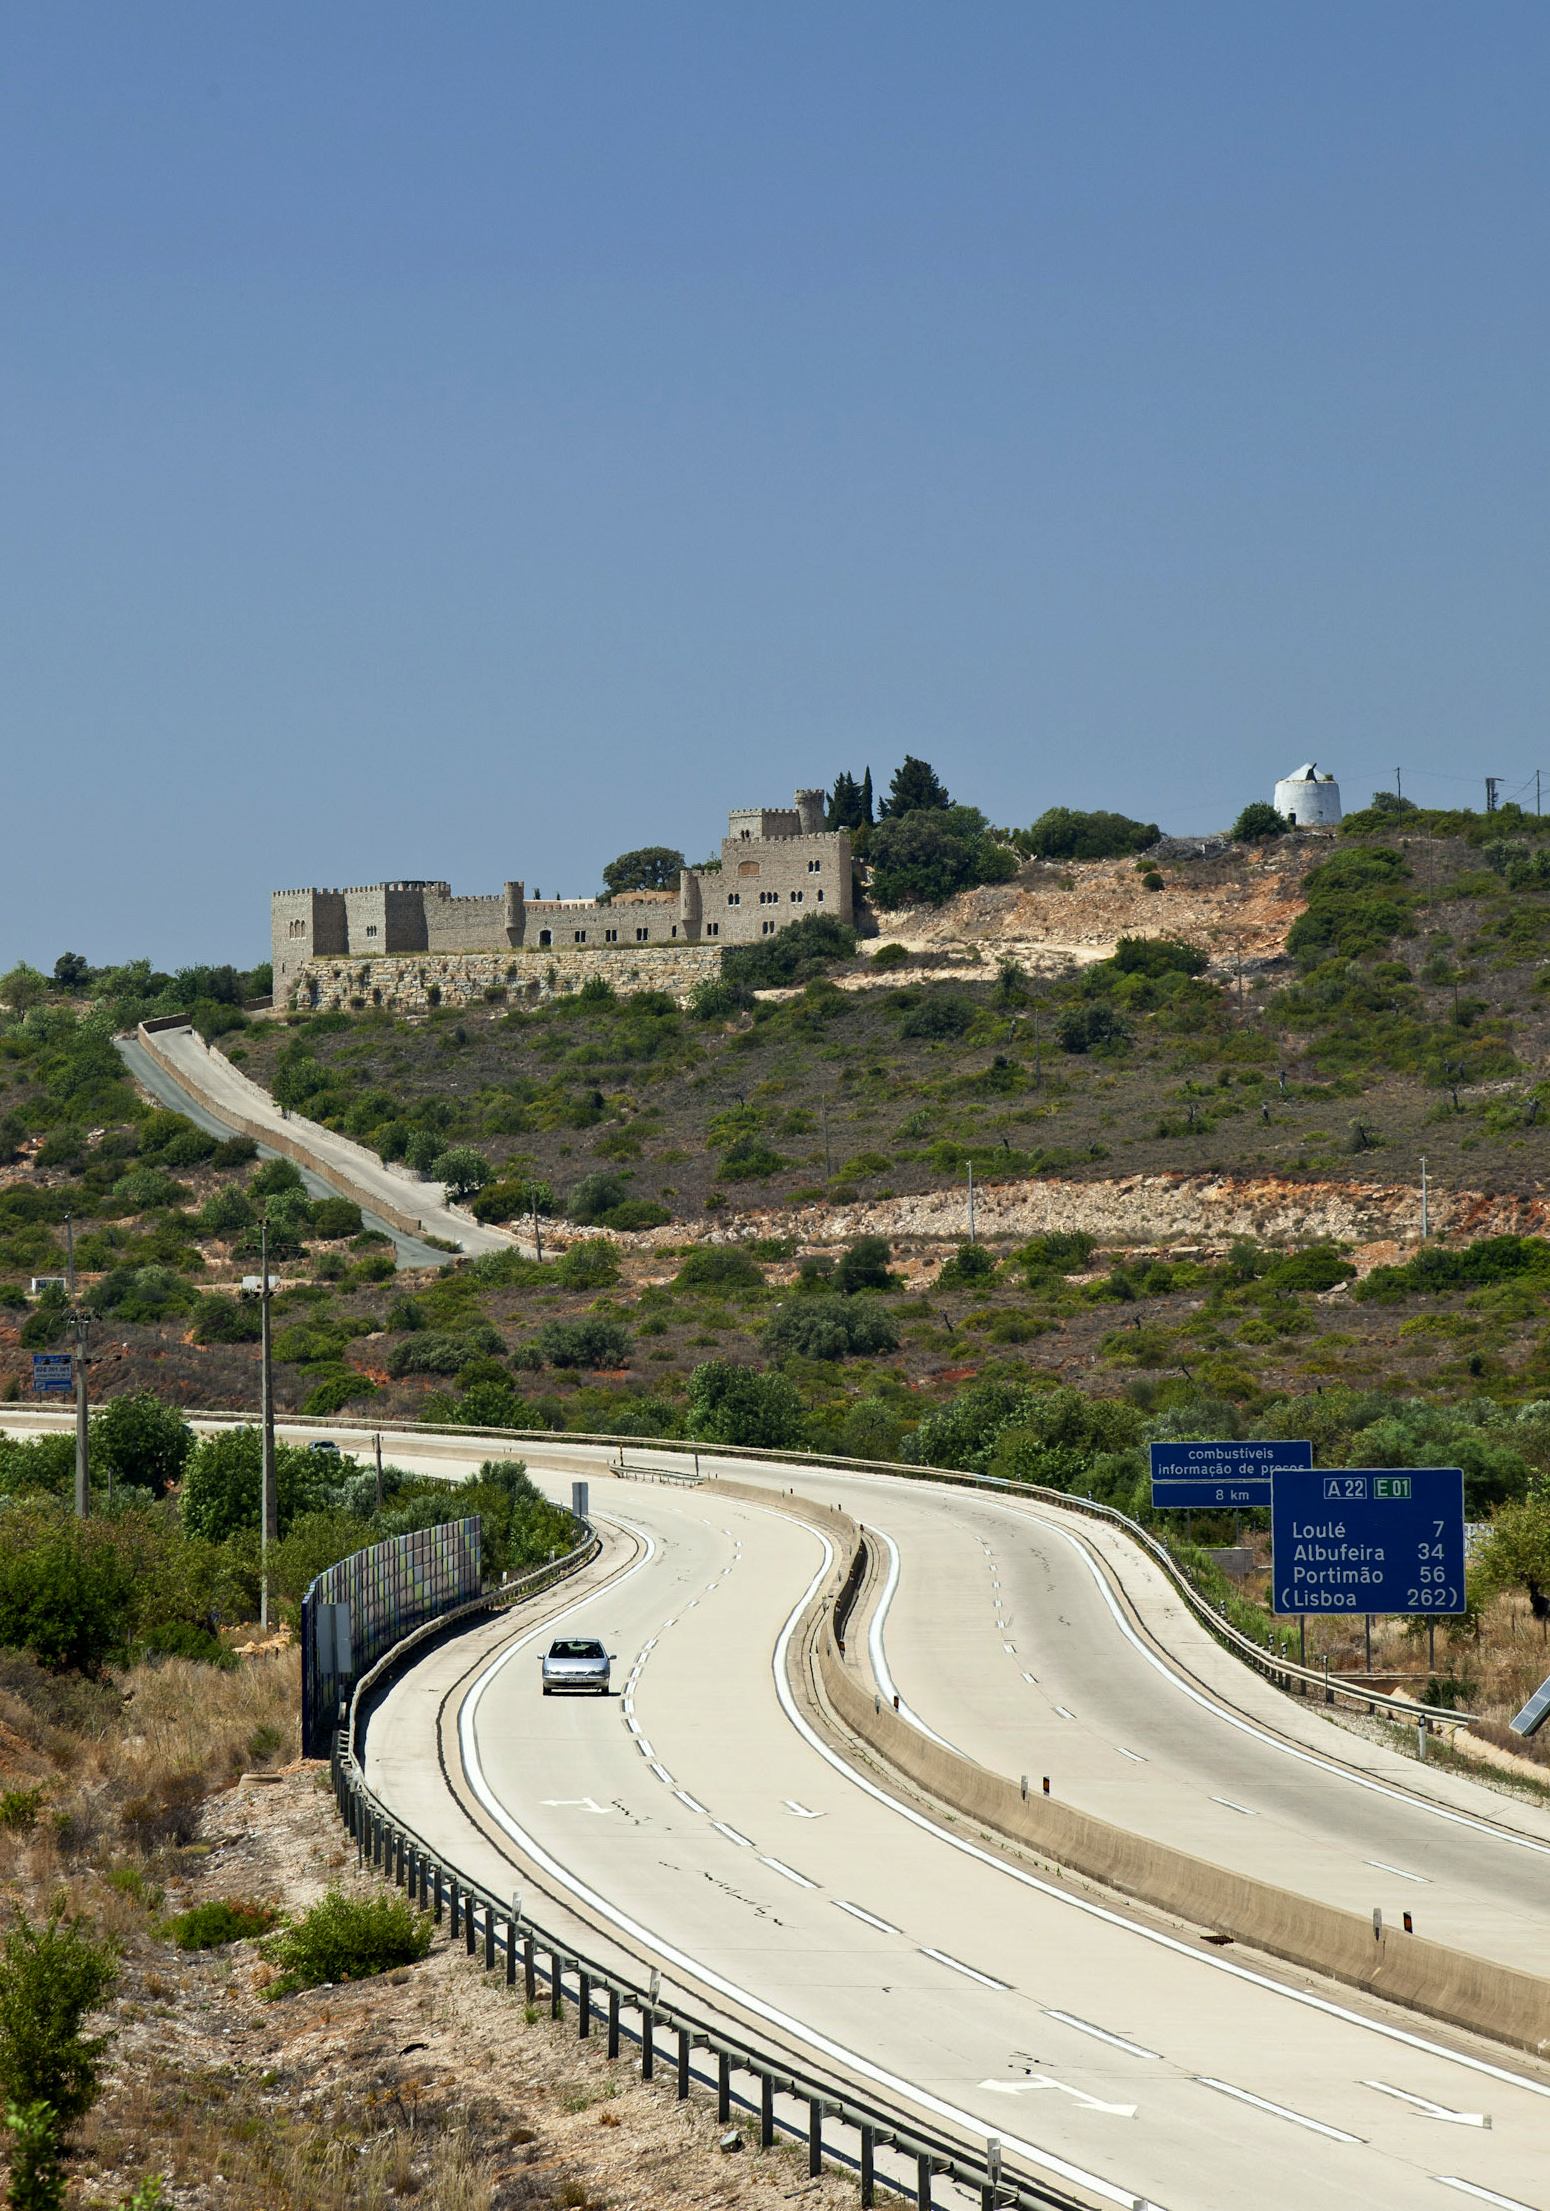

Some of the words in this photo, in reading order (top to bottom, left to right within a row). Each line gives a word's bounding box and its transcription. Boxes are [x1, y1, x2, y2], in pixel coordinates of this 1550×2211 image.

[1188, 1448, 1274, 1460] combustíveis
[1158, 1463, 1232, 1477] informação
[1238, 1463, 1255, 1474] de
[1215, 1489, 1224, 1501] 8
[1230, 1489, 1250, 1501] km
[1327, 1480, 1341, 1497] A
[1345, 1480, 1364, 1497] 22
[1377, 1480, 1388, 1496] E
[1392, 1480, 1409, 1496] 01
[1292, 1521, 1346, 1539] Loulé
[1432, 1520, 1445, 1538] 7
[1293, 1543, 1385, 1561] Albufeira
[1417, 1543, 1445, 1560] 34
[1293, 1566, 1384, 1584] Portimão
[1419, 1566, 1446, 1583] 56
[1281, 1587, 1357, 1608] (Lisboa
[1406, 1586, 1458, 1607] 262)
